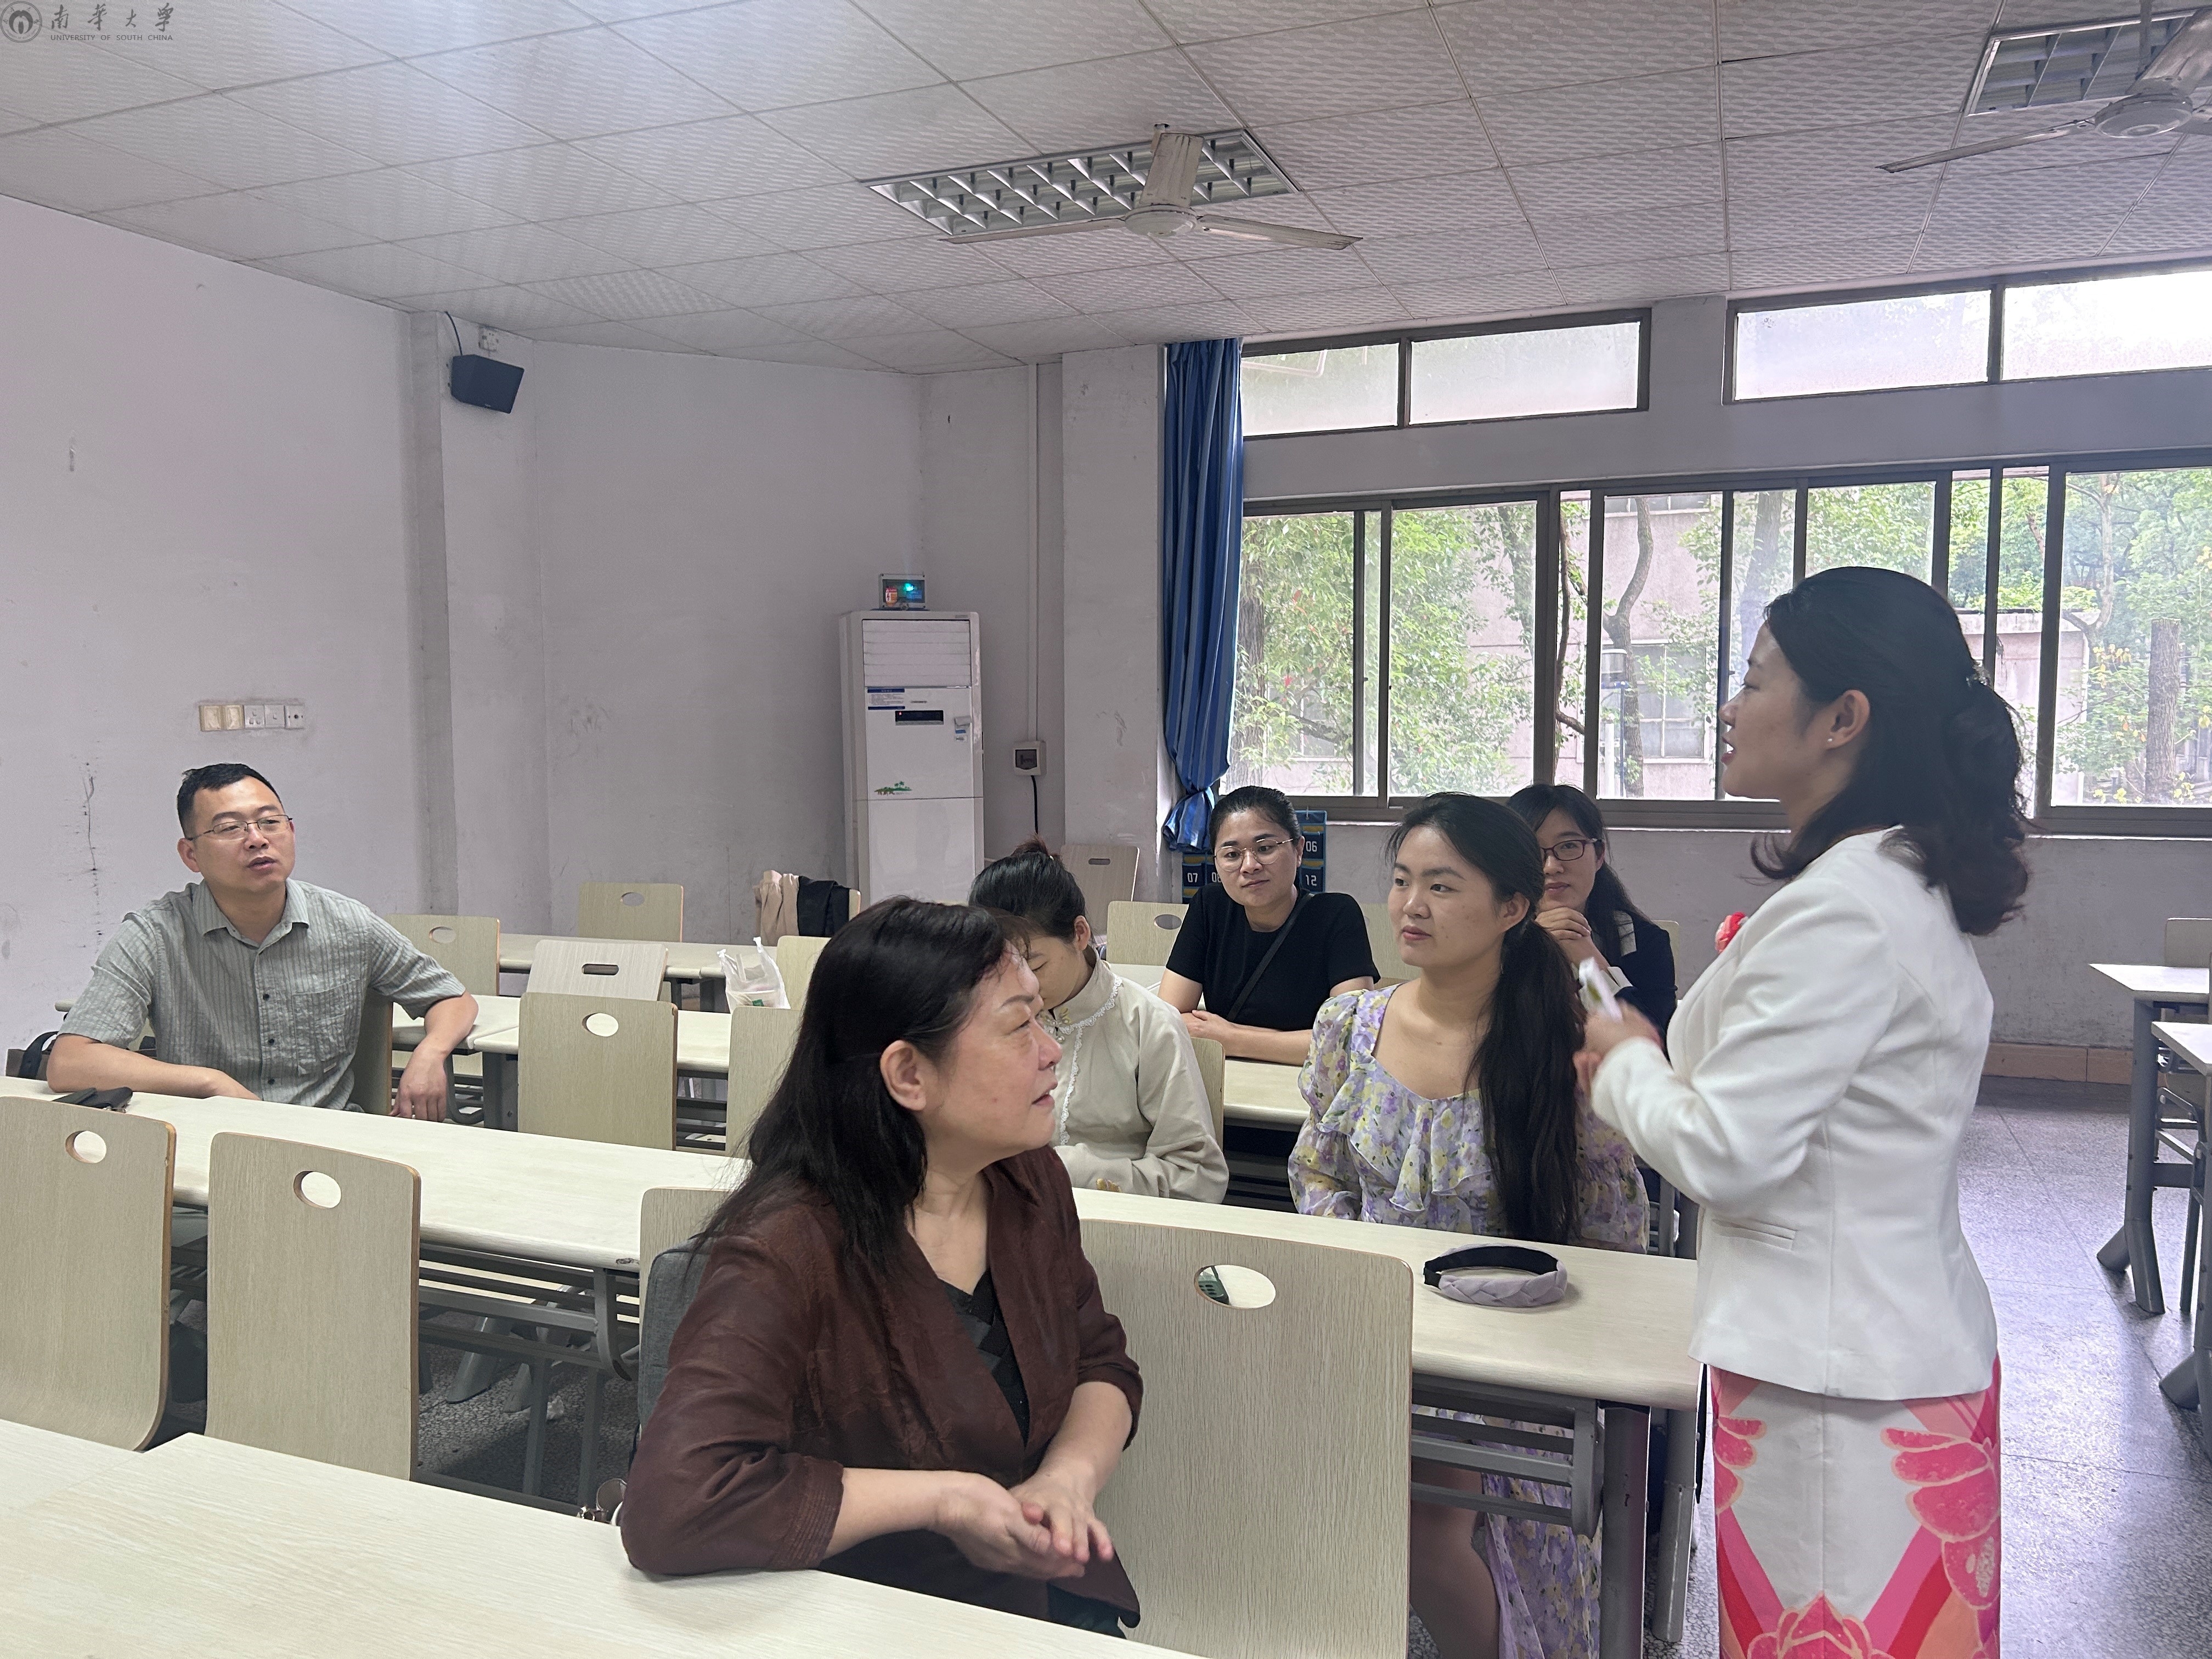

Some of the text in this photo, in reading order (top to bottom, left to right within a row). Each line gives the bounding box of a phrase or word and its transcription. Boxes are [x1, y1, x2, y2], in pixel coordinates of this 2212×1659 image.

[1306, 841, 1317, 852] 06
[1187, 872, 1198, 883] 07
[1305, 874, 1317, 887] 12
